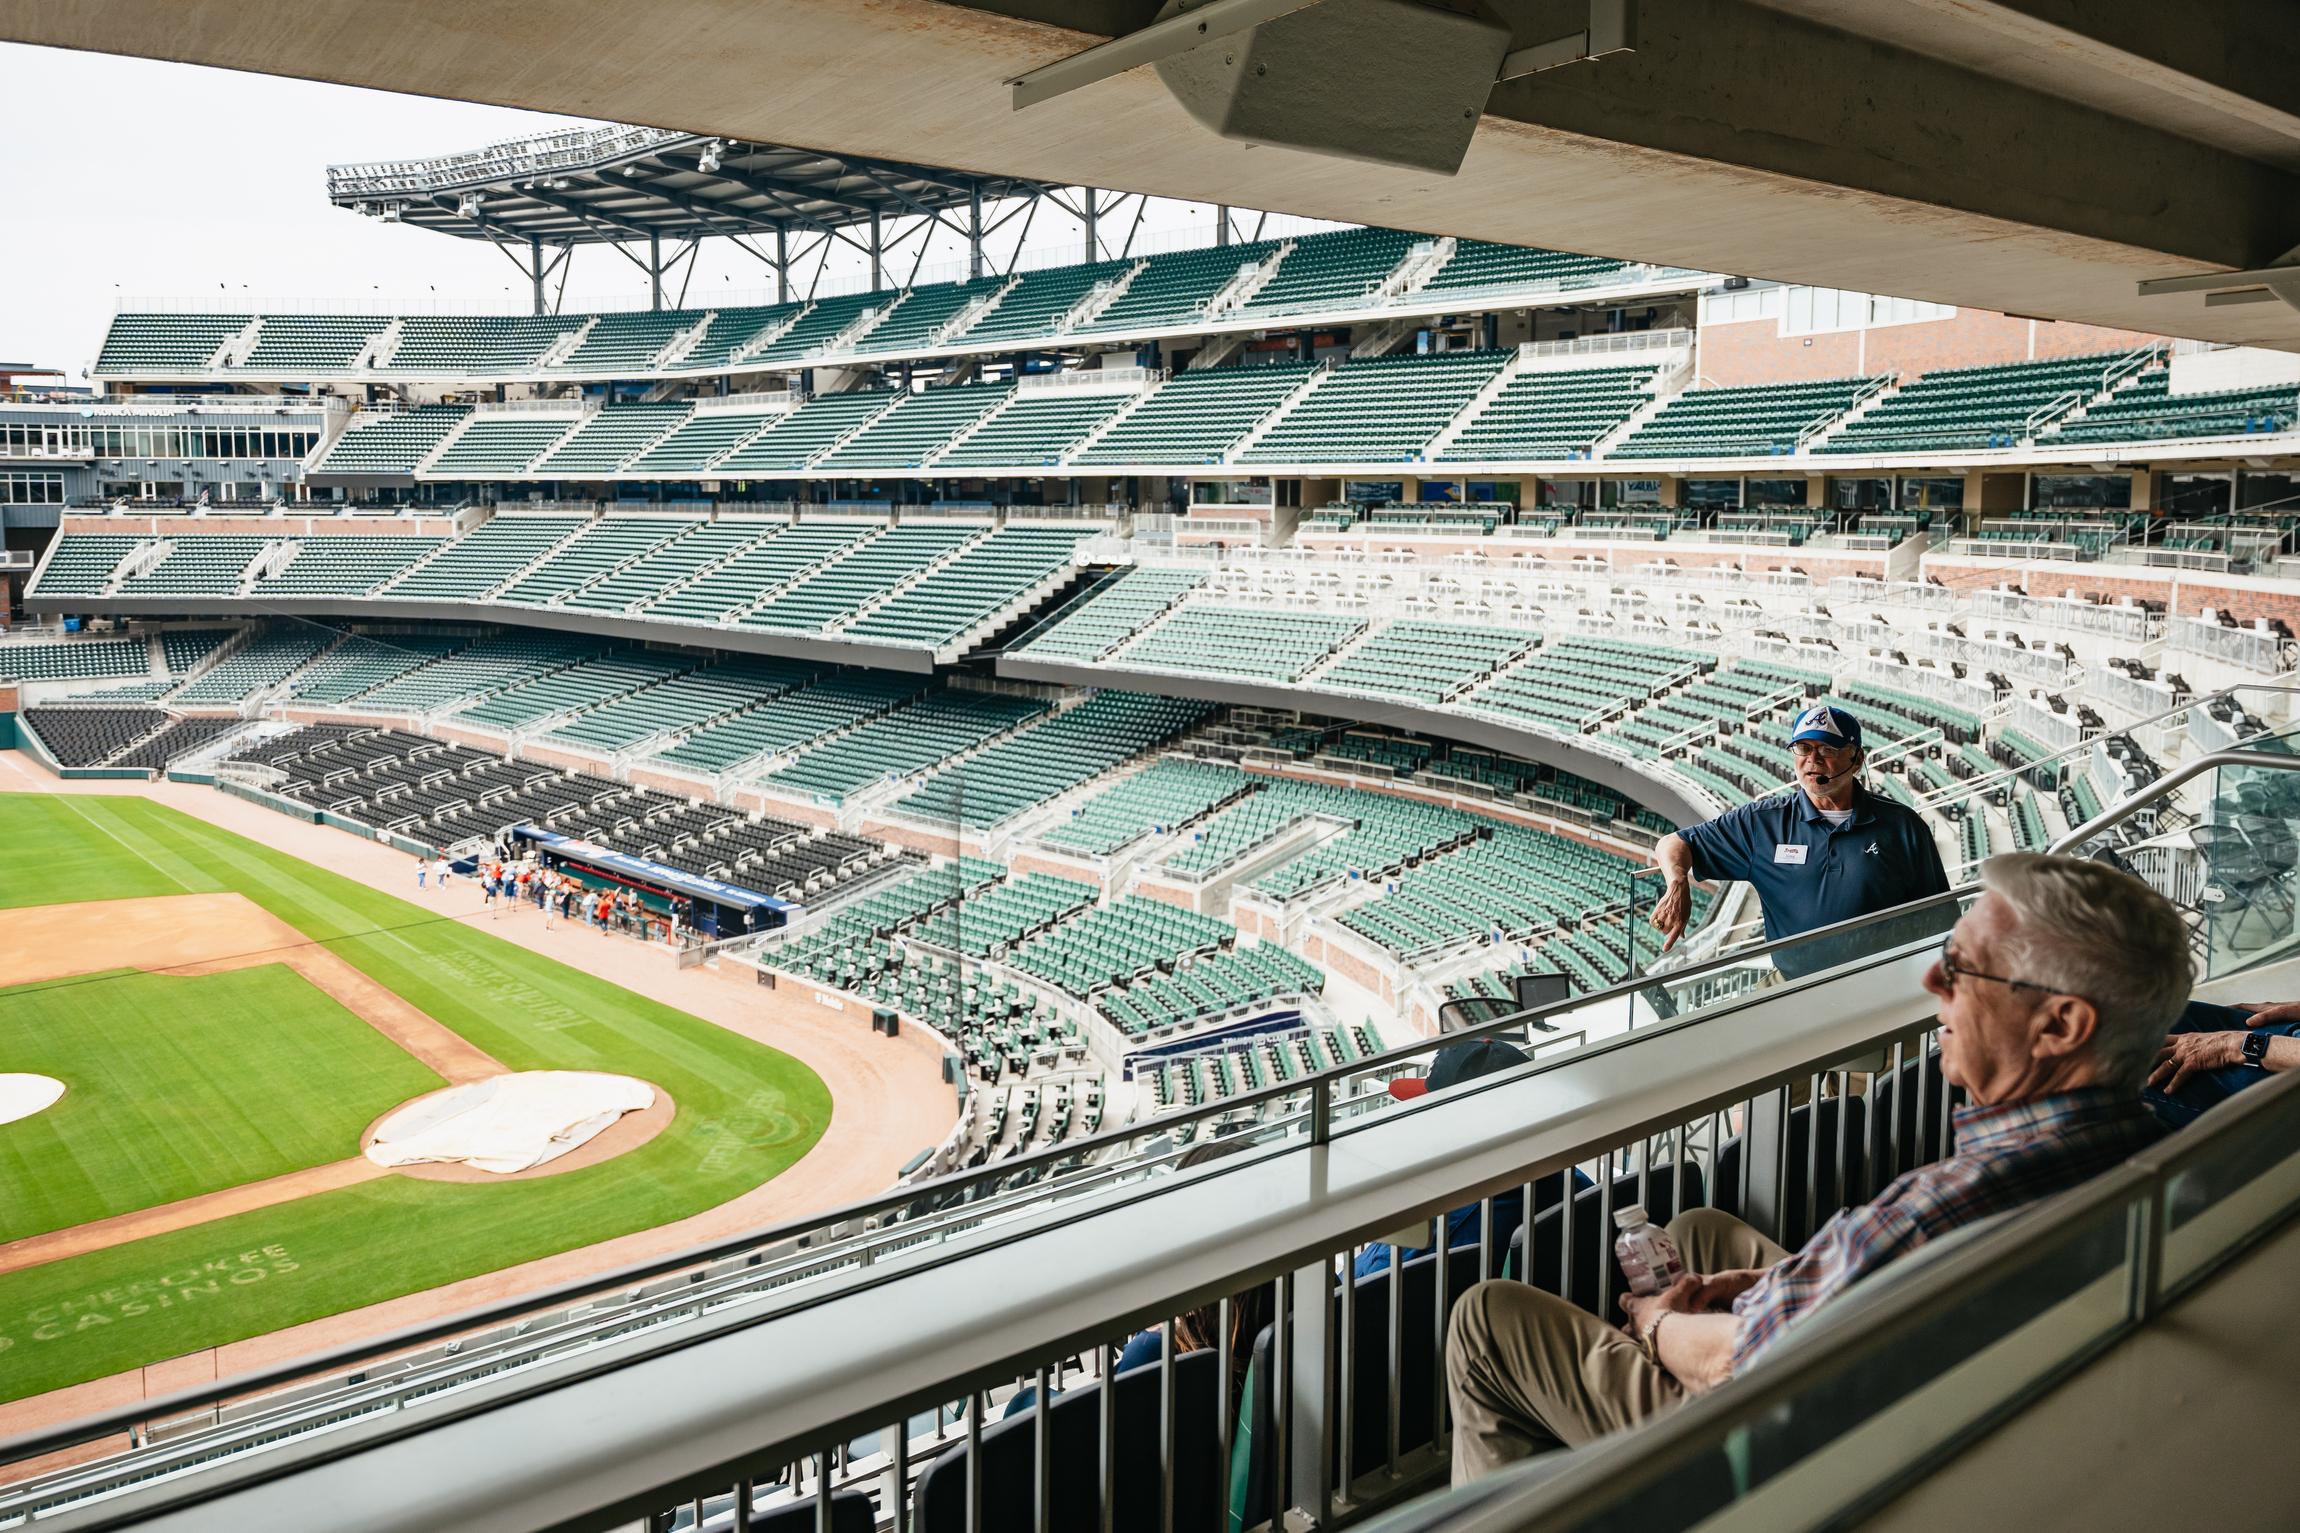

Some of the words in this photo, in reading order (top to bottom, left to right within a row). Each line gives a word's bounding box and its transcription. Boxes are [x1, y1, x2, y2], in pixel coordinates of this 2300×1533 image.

[1864, 842, 1879, 855] A
[27, 1243, 288, 1323] CHEROKEE
[33, 1260, 300, 1340] CASINOS
